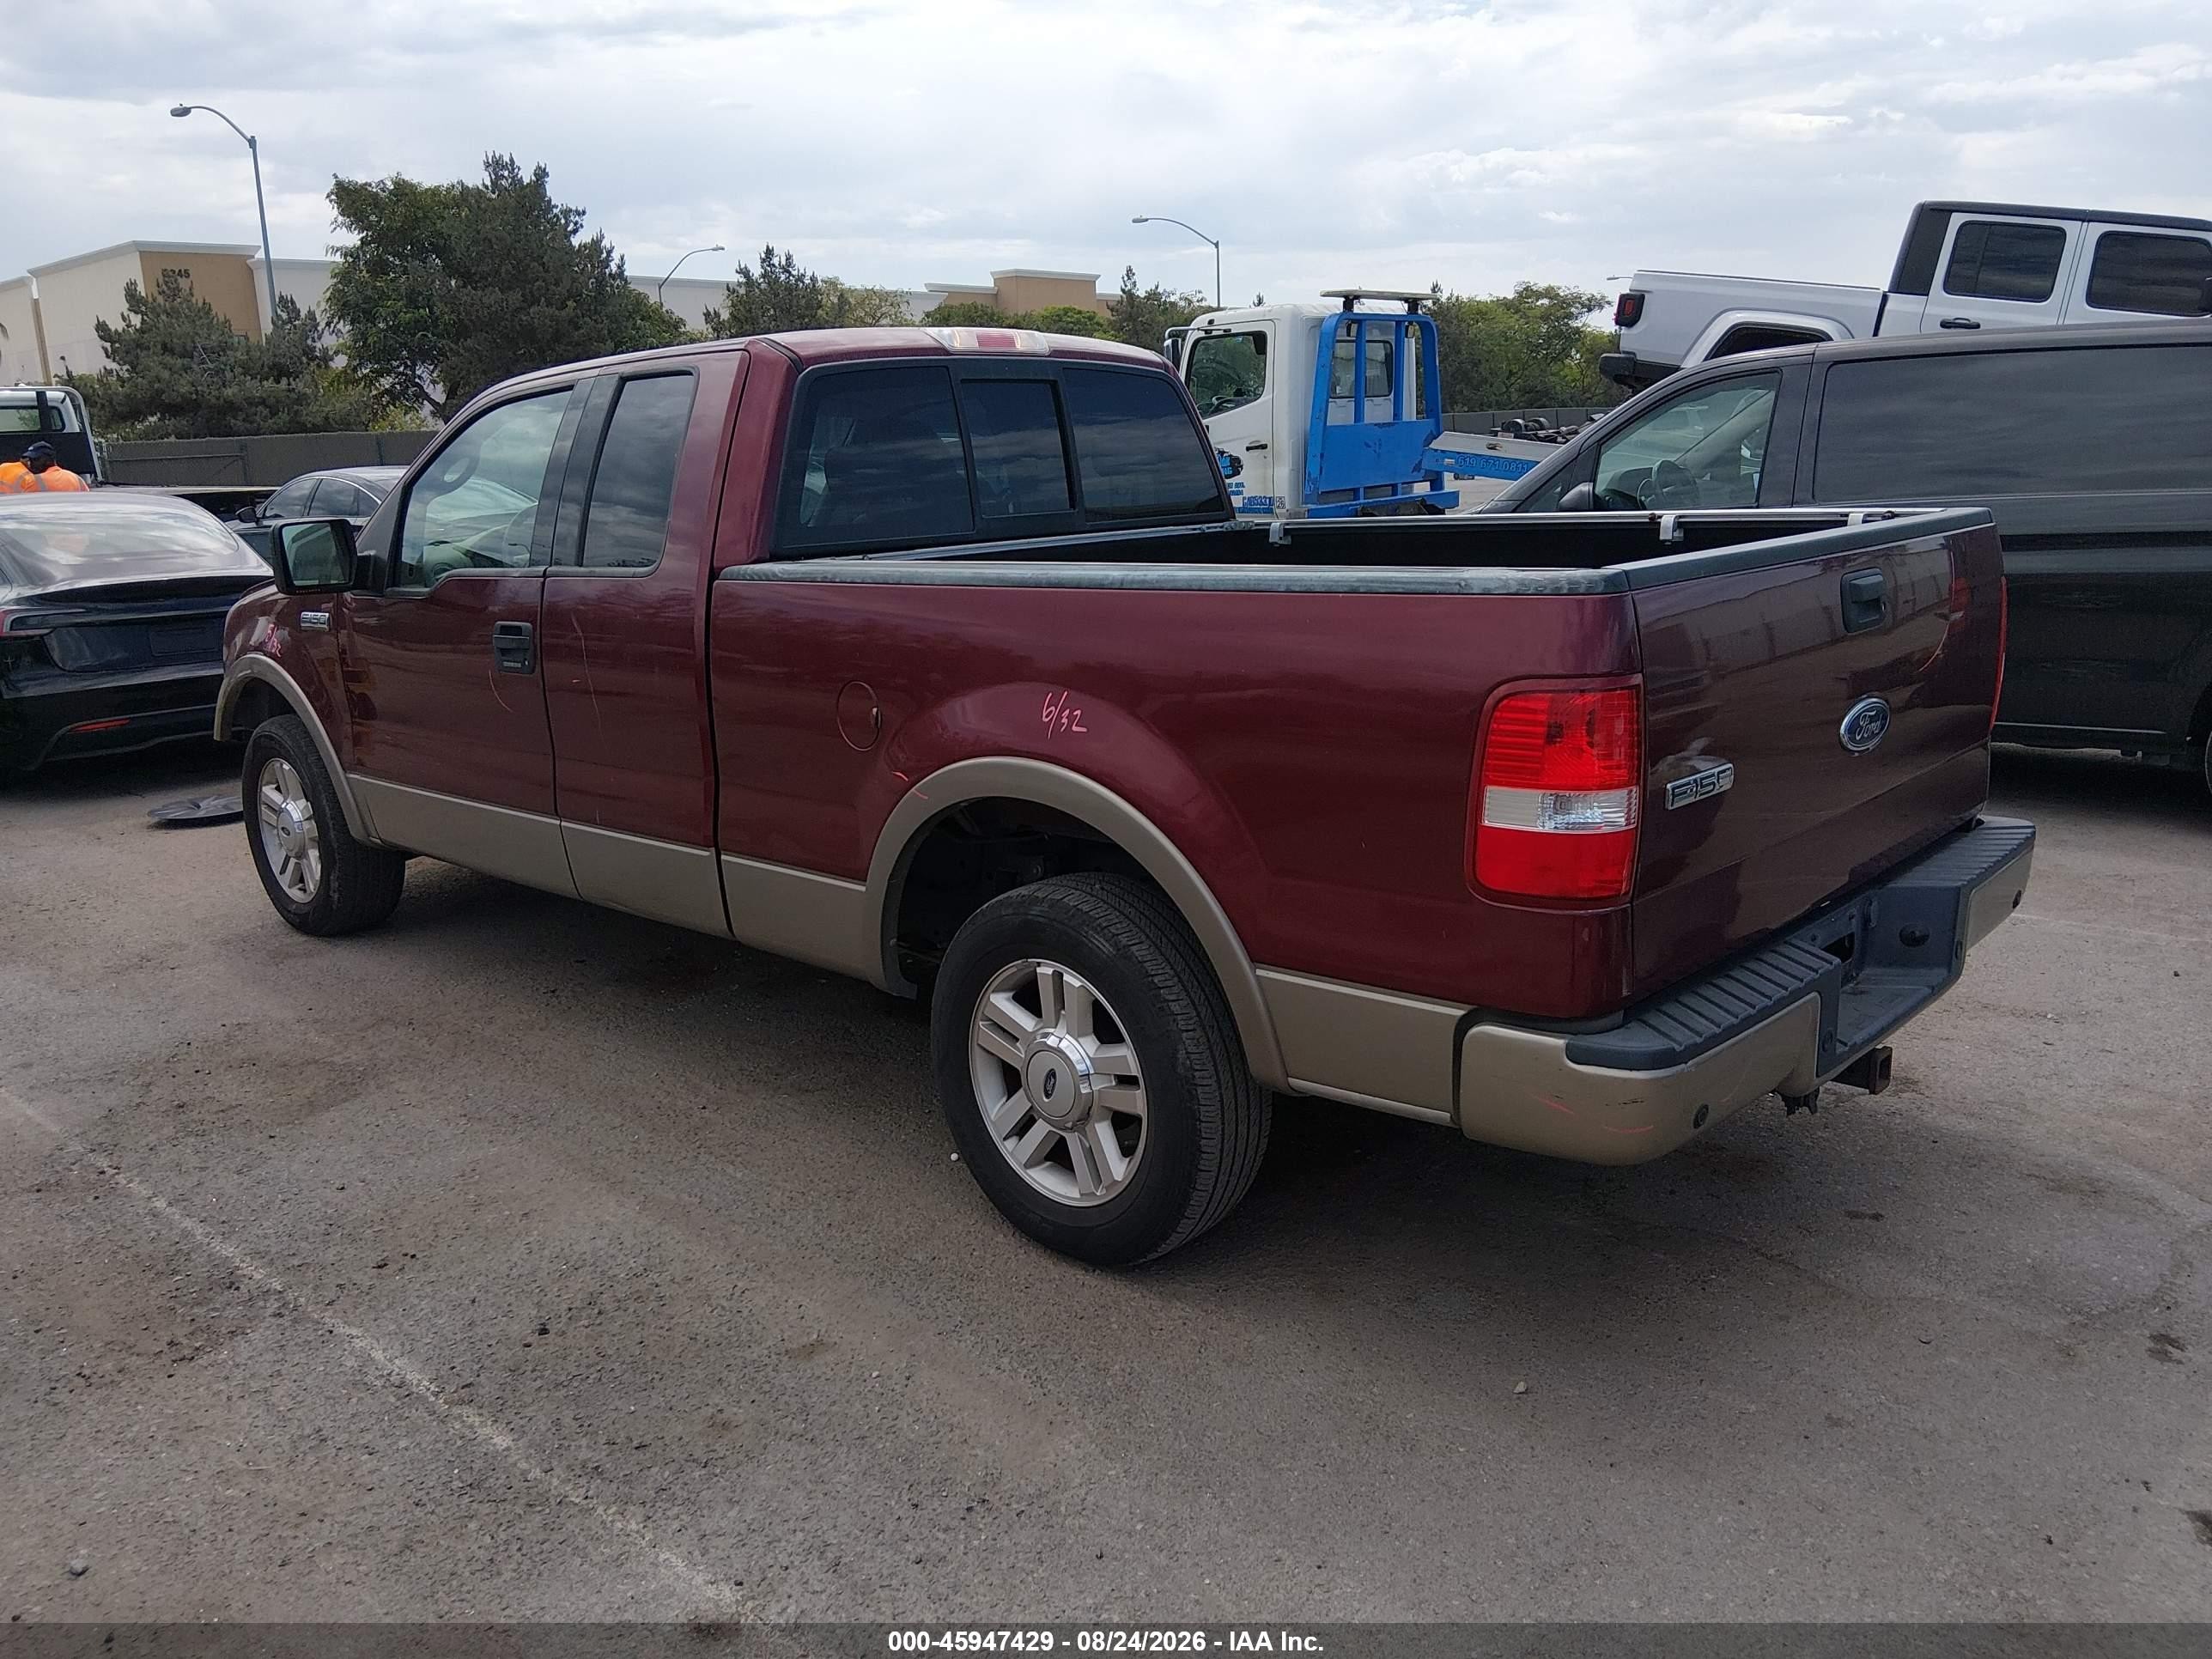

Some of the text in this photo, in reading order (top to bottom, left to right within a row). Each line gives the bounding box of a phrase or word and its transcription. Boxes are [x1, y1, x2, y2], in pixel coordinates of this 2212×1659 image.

[1458, 454, 1476, 468] 619
[1480, 459, 1498, 470] 671
[1042, 690, 1088, 739] 6/32
[1856, 709, 1882, 740] Ford
